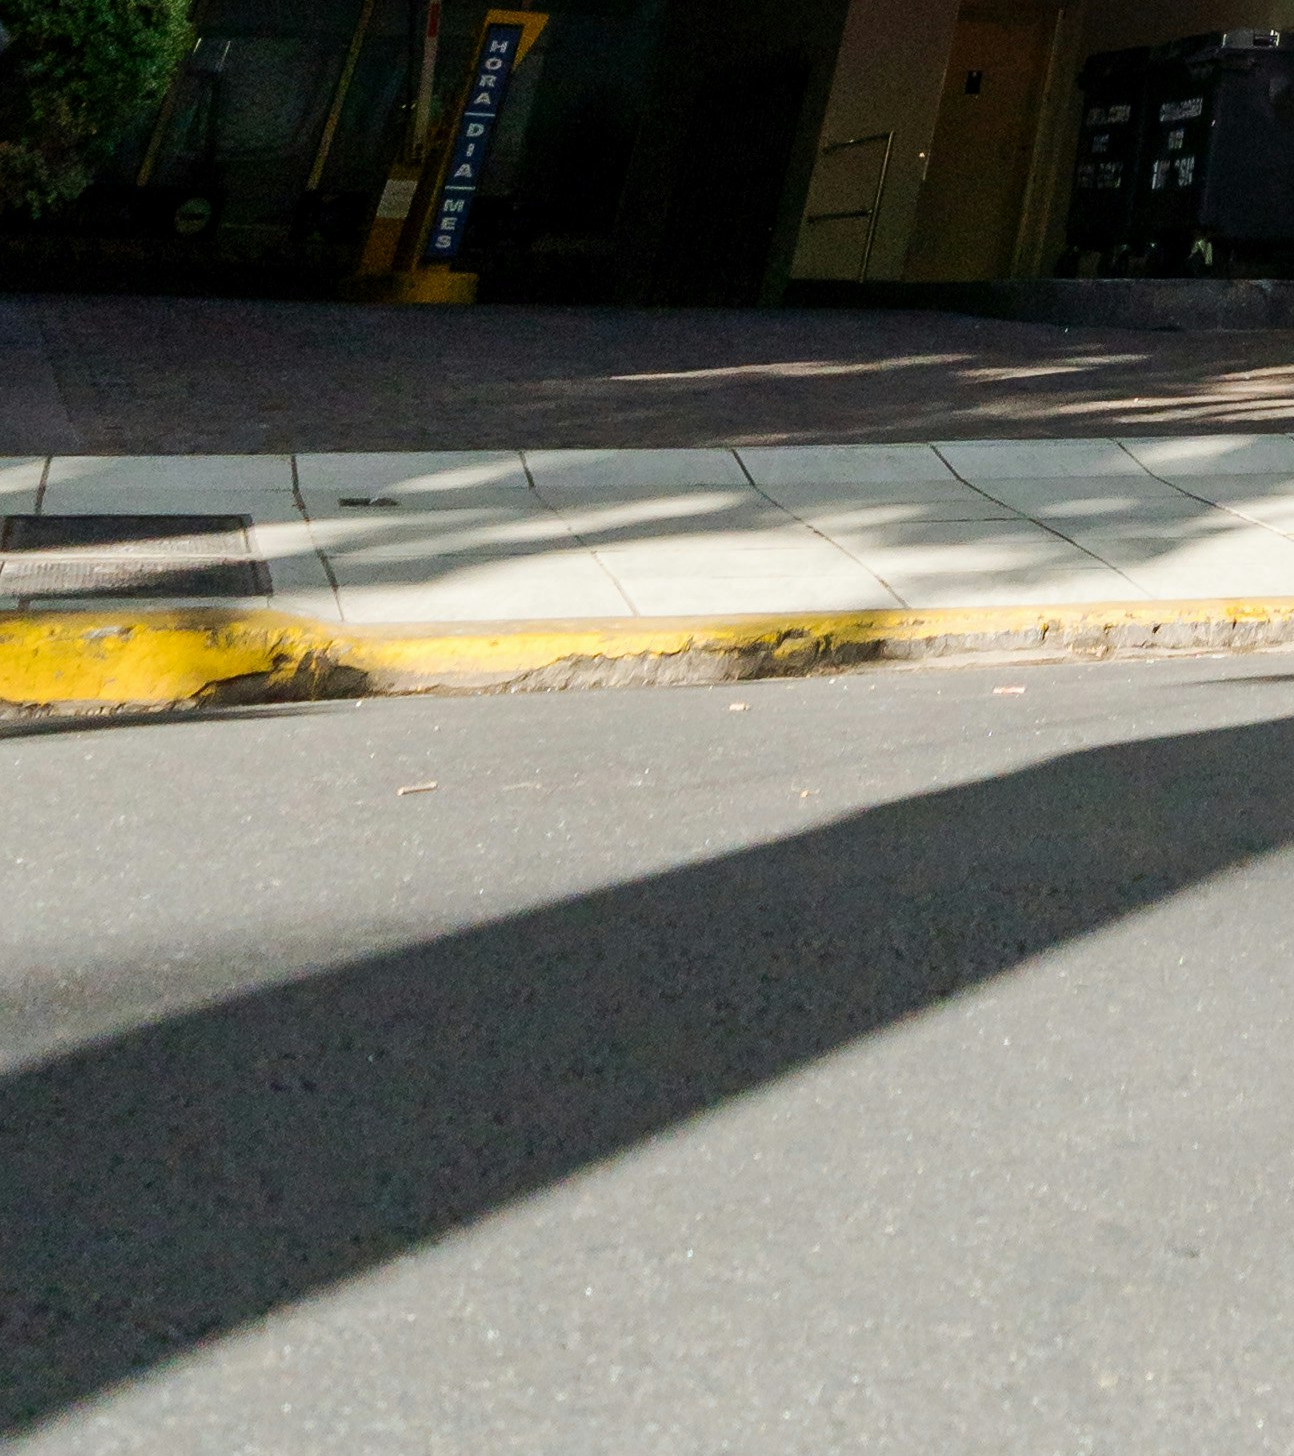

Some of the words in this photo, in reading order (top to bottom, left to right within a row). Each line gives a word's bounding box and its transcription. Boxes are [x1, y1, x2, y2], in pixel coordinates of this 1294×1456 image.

[474, 40, 509, 105] HORA
[454, 123, 485, 178] DIA
[435, 199, 465, 249] MES
